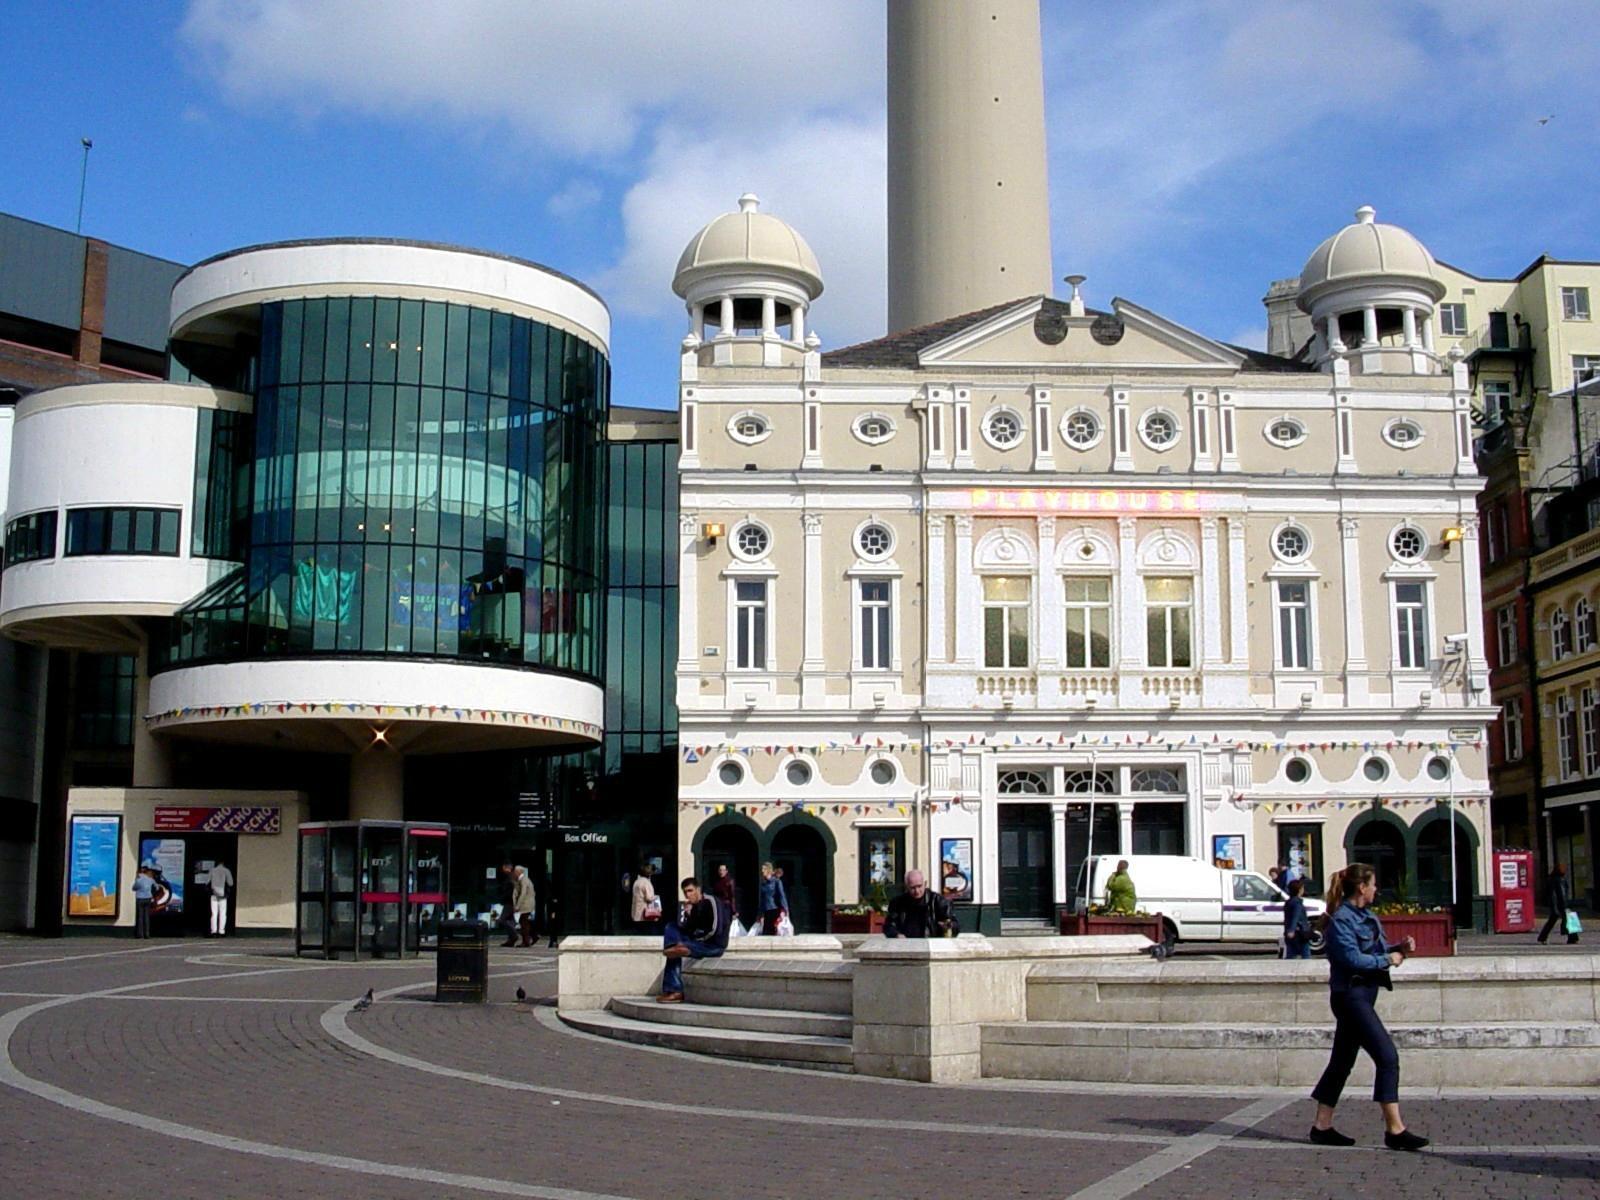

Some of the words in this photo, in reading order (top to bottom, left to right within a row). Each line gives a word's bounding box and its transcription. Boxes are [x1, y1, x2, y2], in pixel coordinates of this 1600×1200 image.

[972, 489, 1200, 510] PLAYHOUSE
[203, 807, 232, 832] ECHO
[223, 807, 252, 832] ECHO
[243, 807, 272, 832] ECHO
[564, 832, 580, 843] Box
[581, 832, 608, 843] Office
